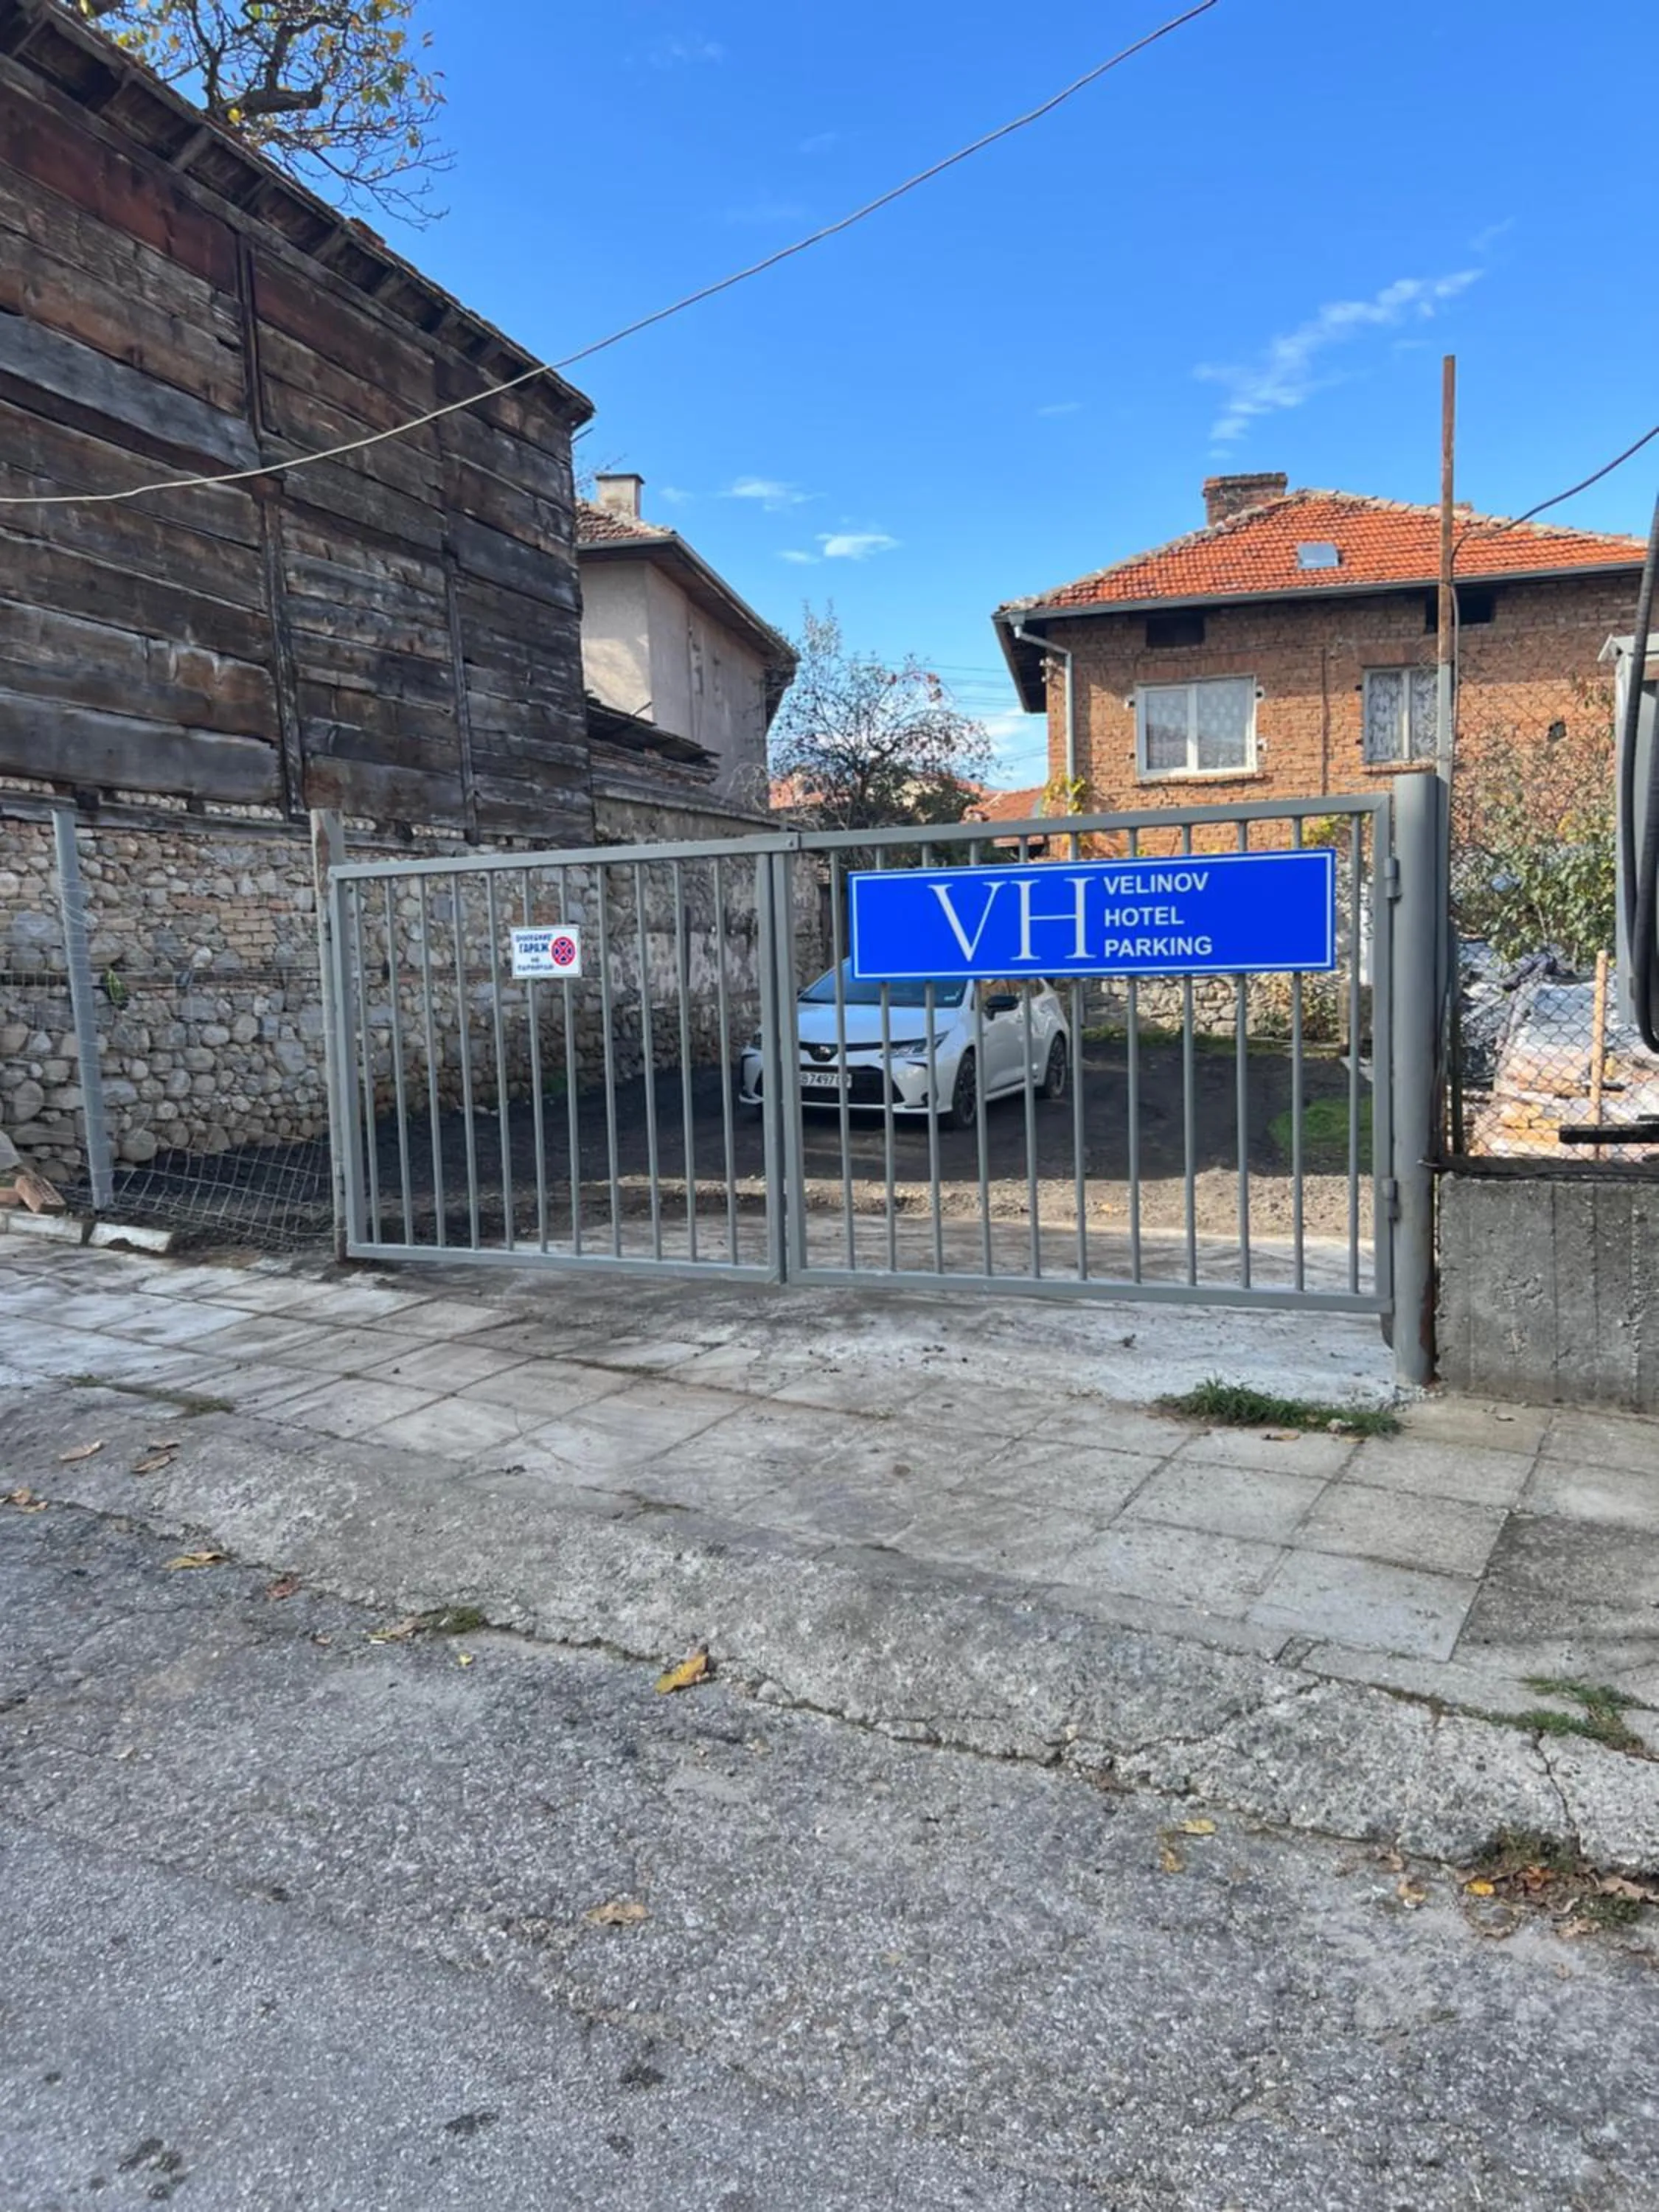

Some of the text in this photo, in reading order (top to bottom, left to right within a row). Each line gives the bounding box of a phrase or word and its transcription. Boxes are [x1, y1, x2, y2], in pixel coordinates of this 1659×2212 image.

[1104, 872, 1209, 895] VELINOV
[928, 877, 1096, 962] VH
[1104, 906, 1184, 928] HOTEL
[1104, 936, 1212, 958] PARKING
